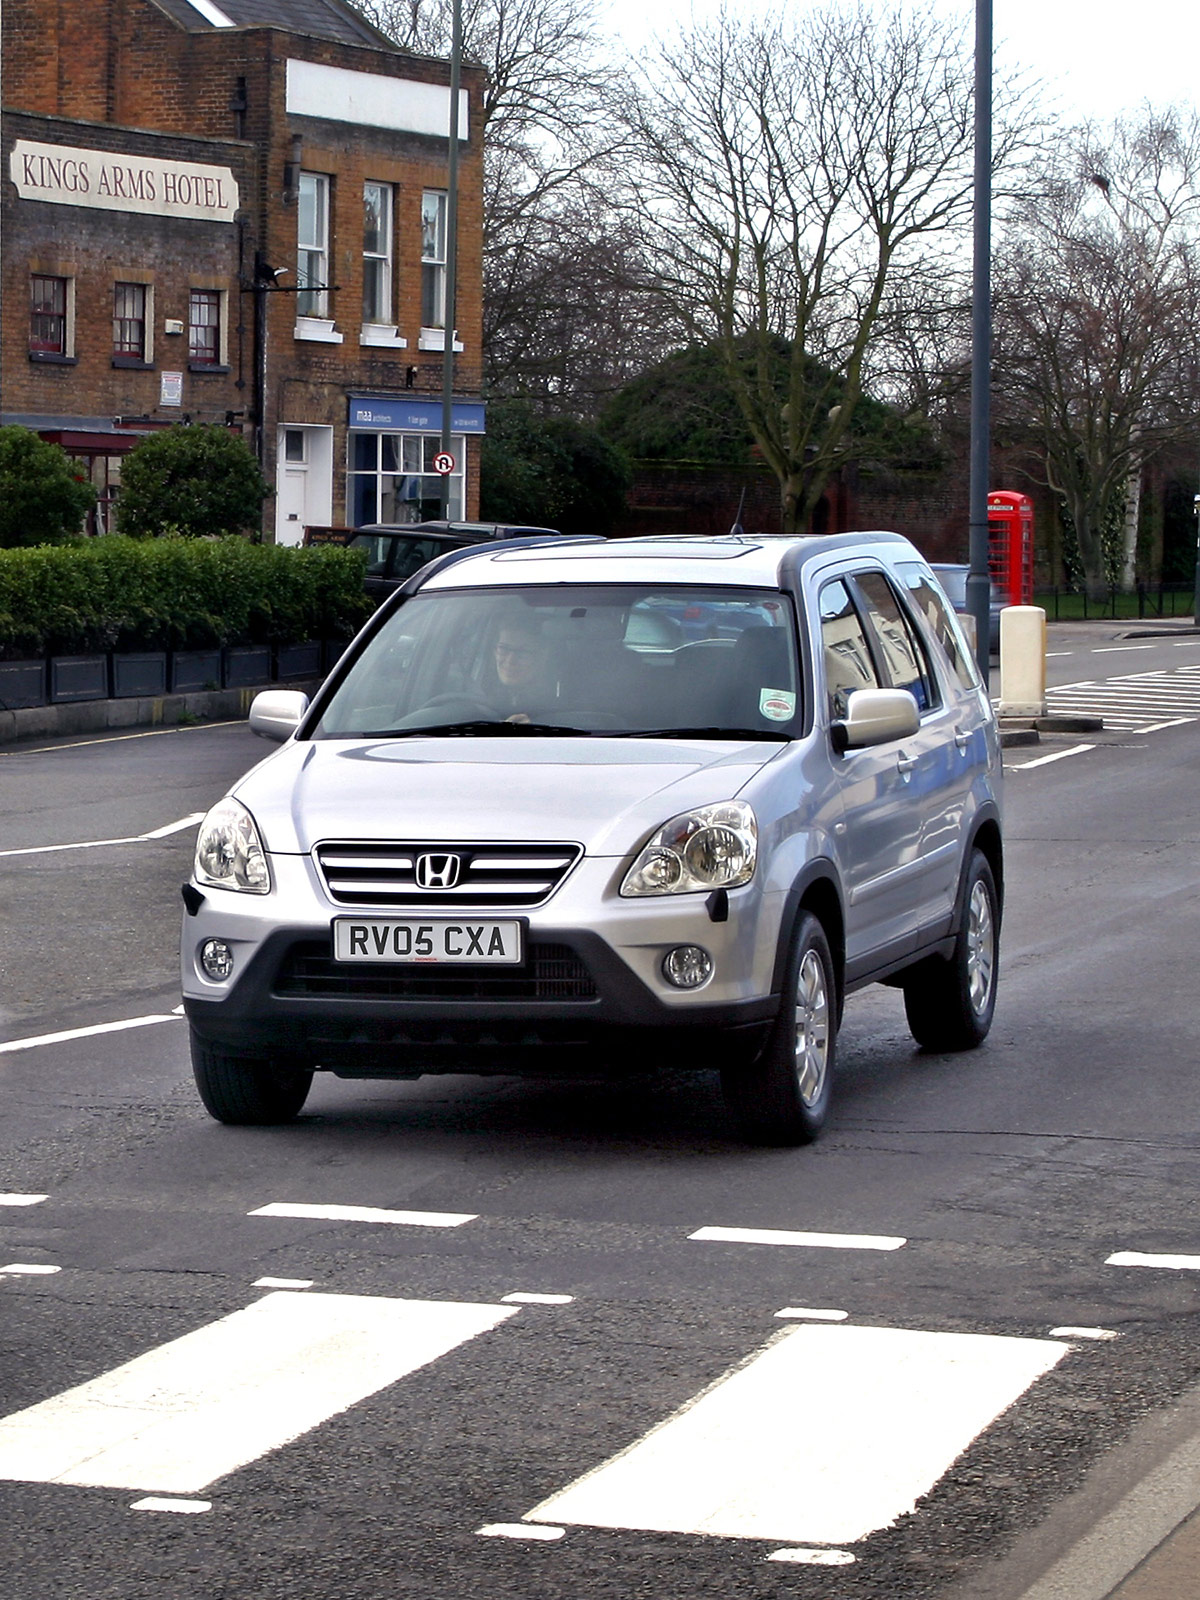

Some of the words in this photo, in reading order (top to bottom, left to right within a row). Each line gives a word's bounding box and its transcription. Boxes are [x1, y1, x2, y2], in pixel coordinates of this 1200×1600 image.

[22, 154, 90, 193] KINGS
[97, 165, 156, 200] ARMS
[163, 172, 229, 209] HOTEL
[350, 925, 433, 956] RV05
[444, 925, 506, 956] CXA
